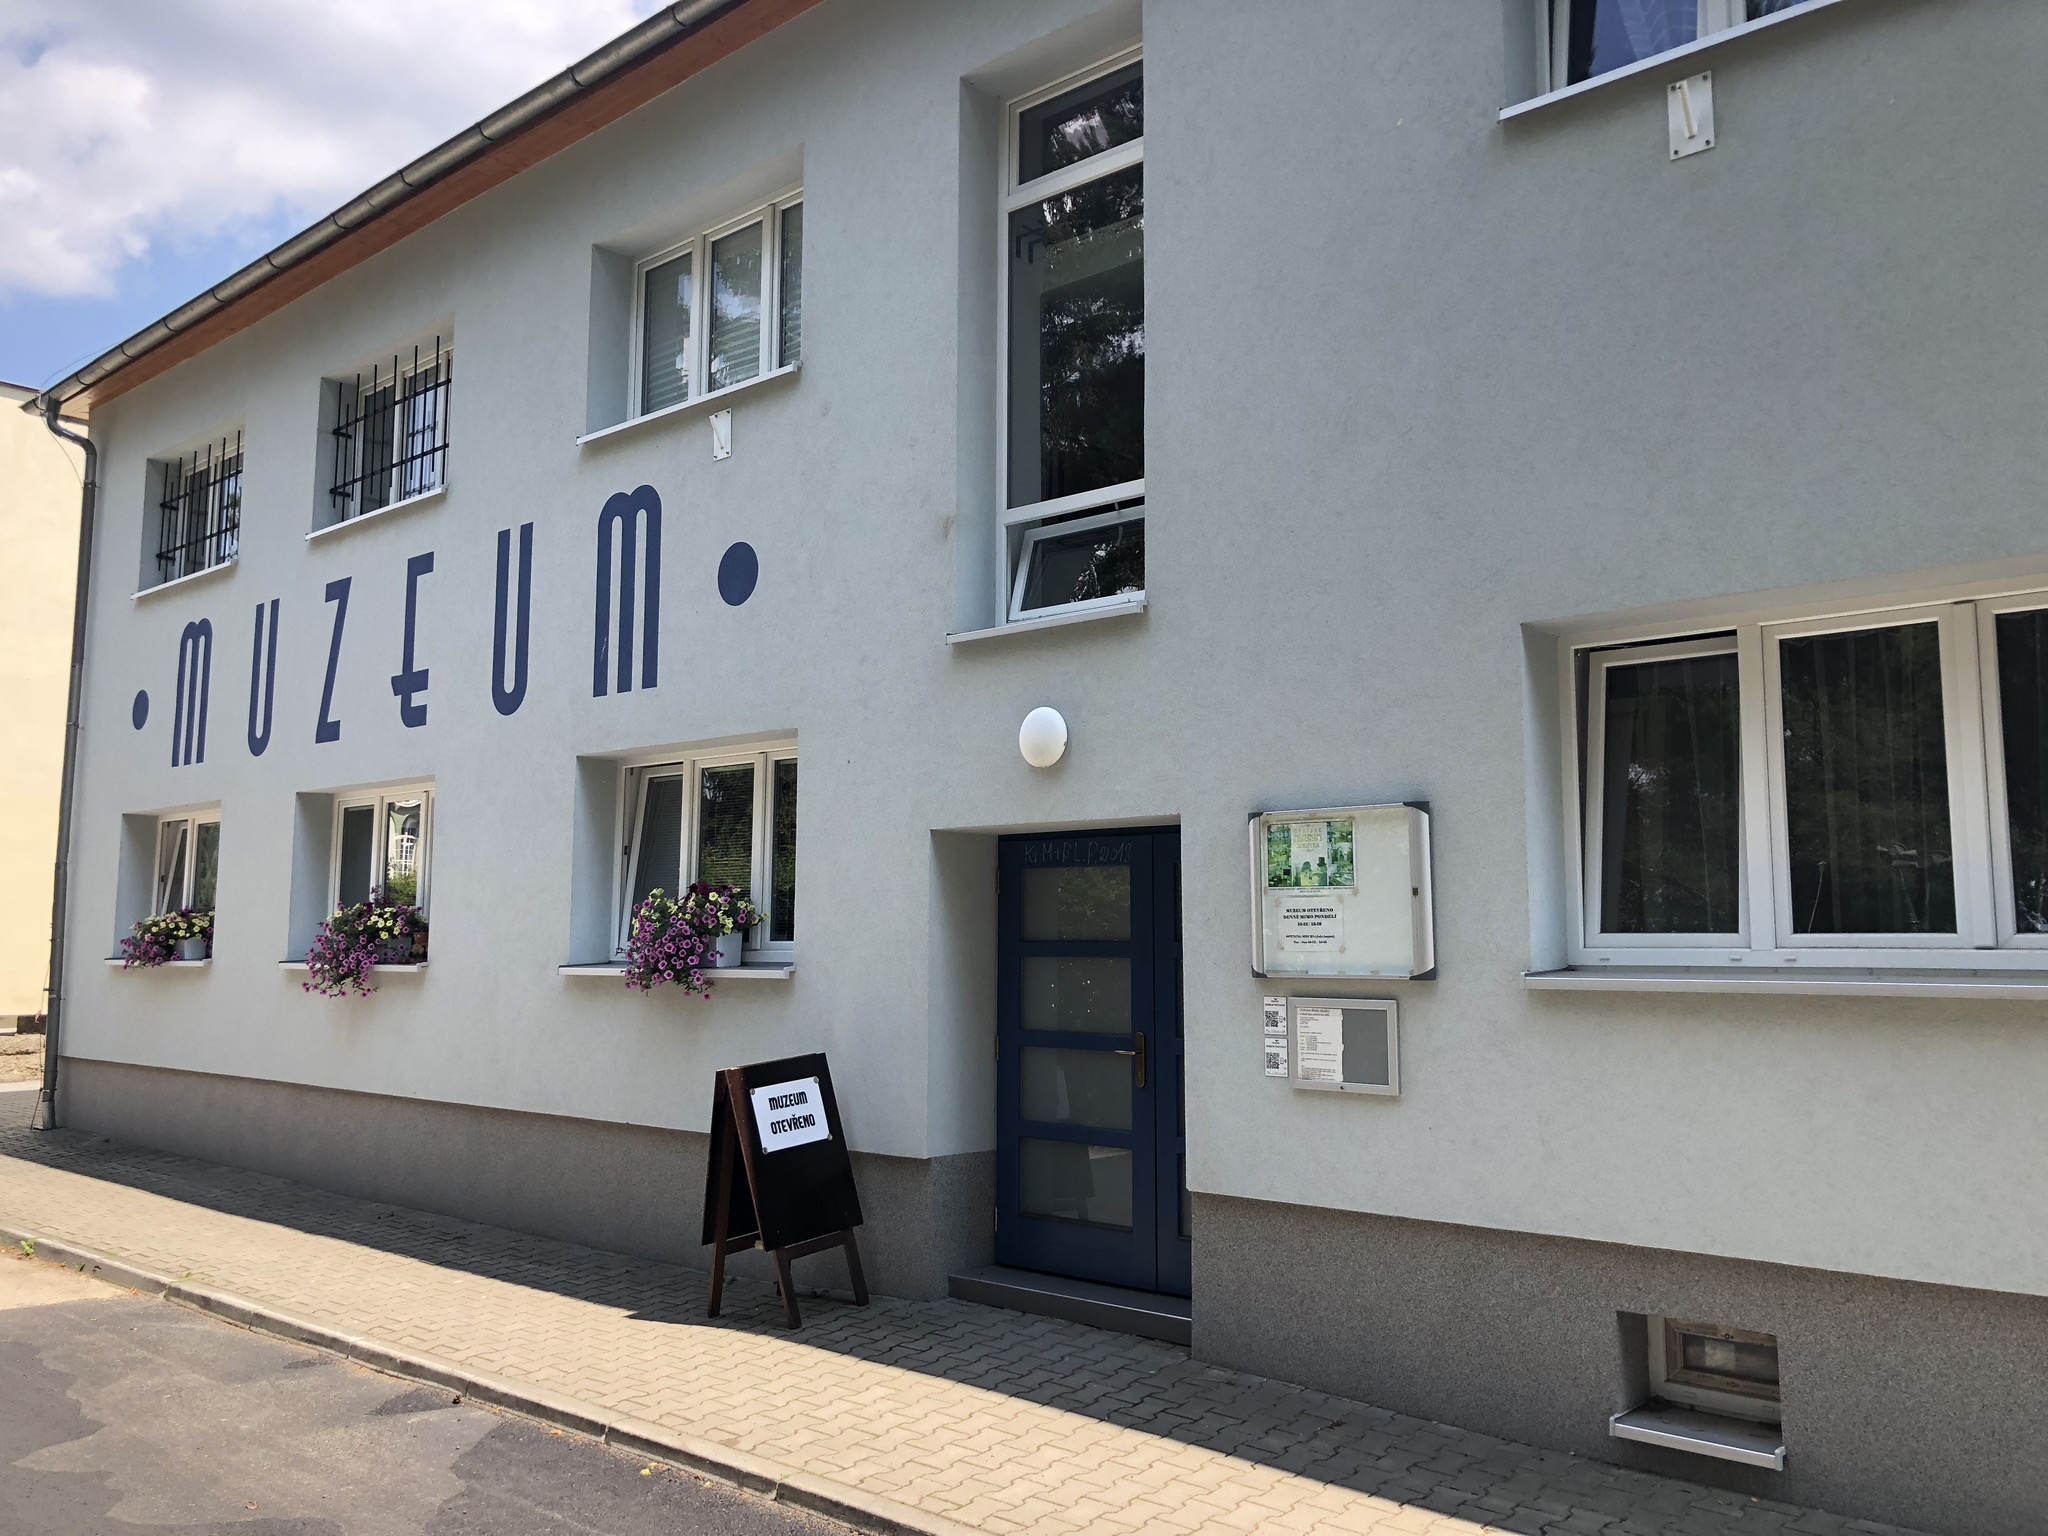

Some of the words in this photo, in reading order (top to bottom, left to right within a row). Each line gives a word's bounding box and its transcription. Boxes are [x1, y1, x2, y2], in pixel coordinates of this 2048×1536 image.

[172, 484, 662, 768] MUZEUM
[768, 1091, 808, 1111] MUZEUM
[770, 1113, 816, 1135] OTEVŘENO
